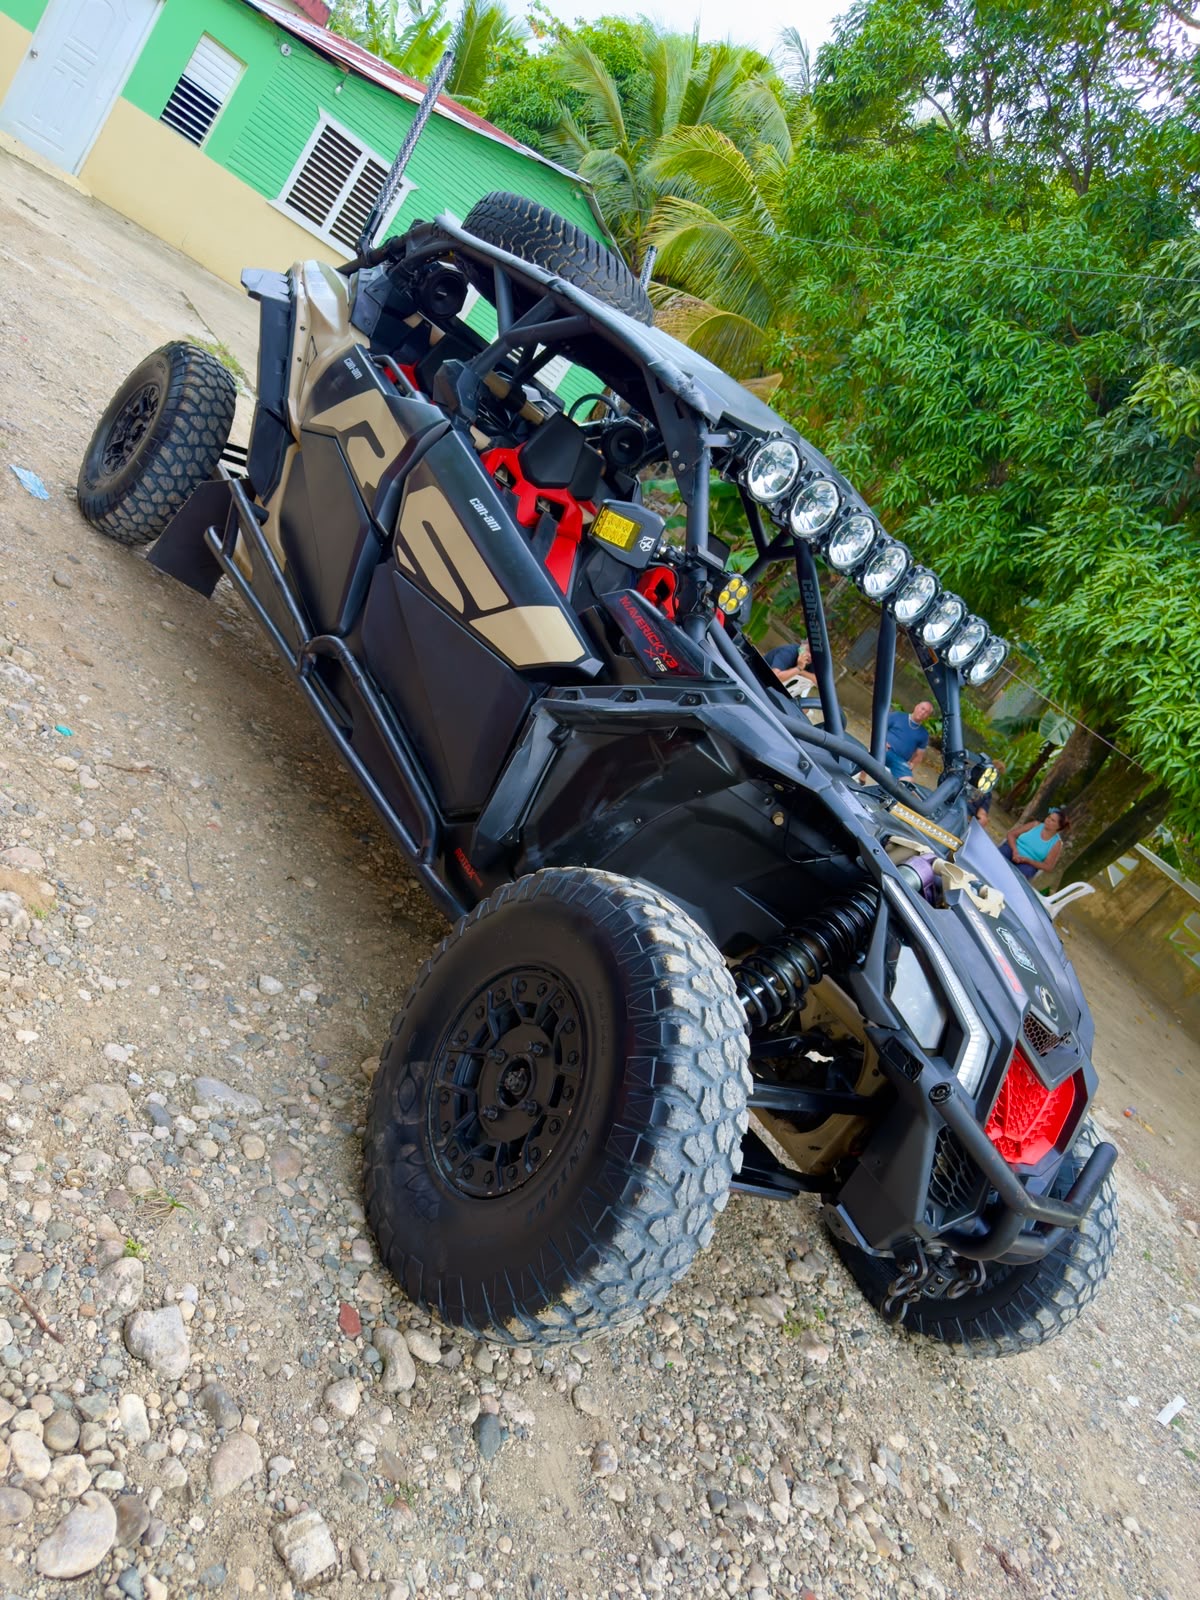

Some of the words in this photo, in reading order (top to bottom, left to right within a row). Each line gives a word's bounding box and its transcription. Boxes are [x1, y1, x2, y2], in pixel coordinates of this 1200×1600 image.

[343, 357, 363, 380] can-am
[469, 497, 502, 532] can-am
[619, 595, 665, 652] MAVERICK
[659, 649, 679, 669] X3
